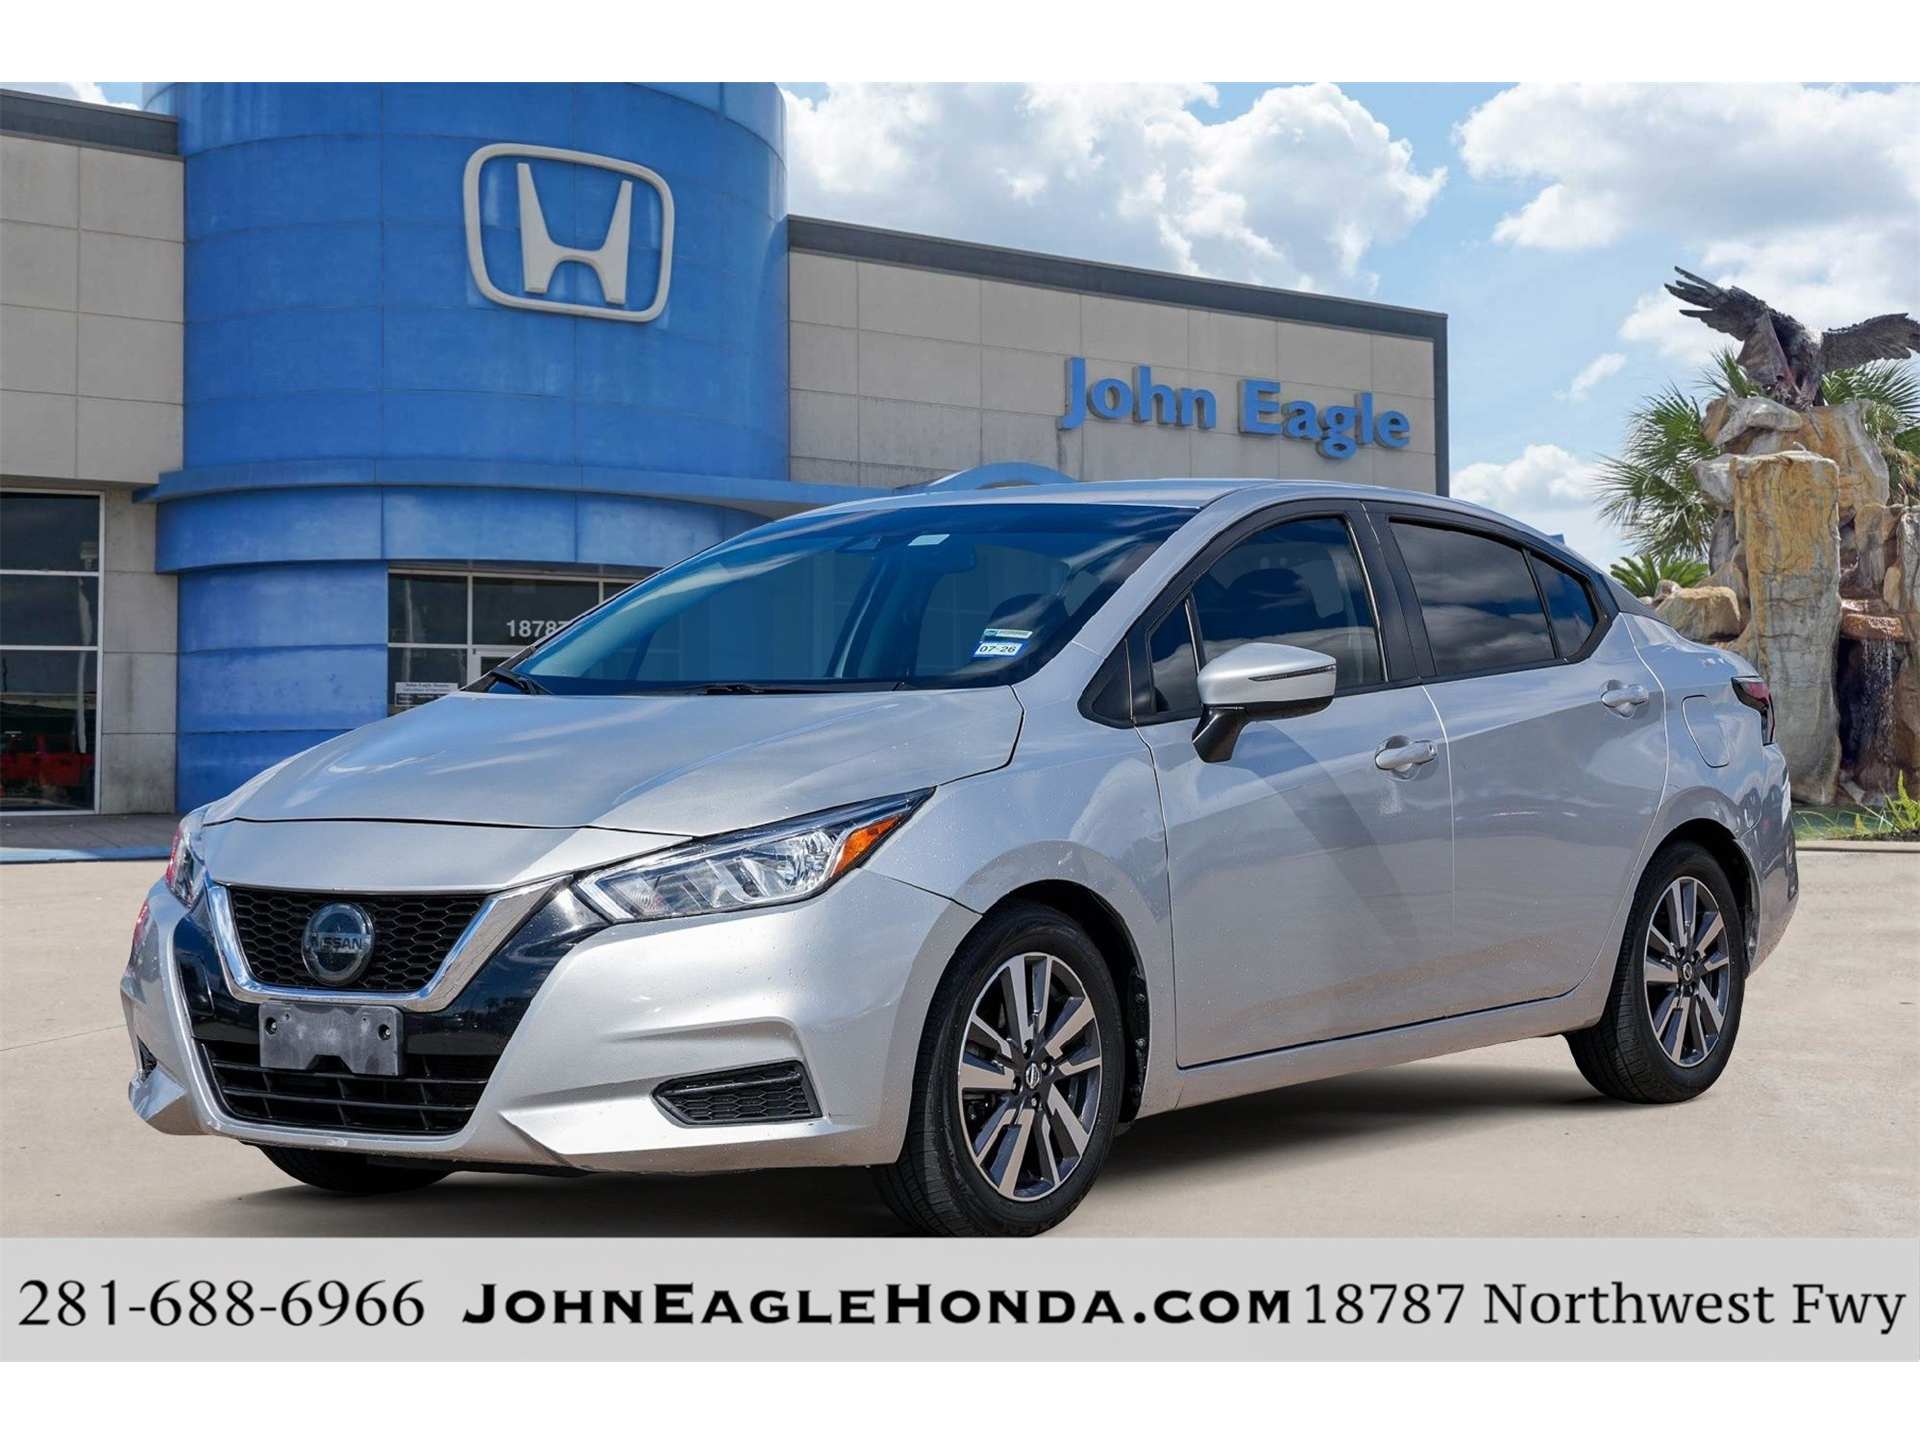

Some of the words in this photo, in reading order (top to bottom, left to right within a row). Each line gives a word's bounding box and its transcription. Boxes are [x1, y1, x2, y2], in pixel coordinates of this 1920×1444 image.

[1056, 356, 1217, 431] John
[1237, 379, 1411, 460] Eagle
[311, 936, 364, 952] NISSAN
